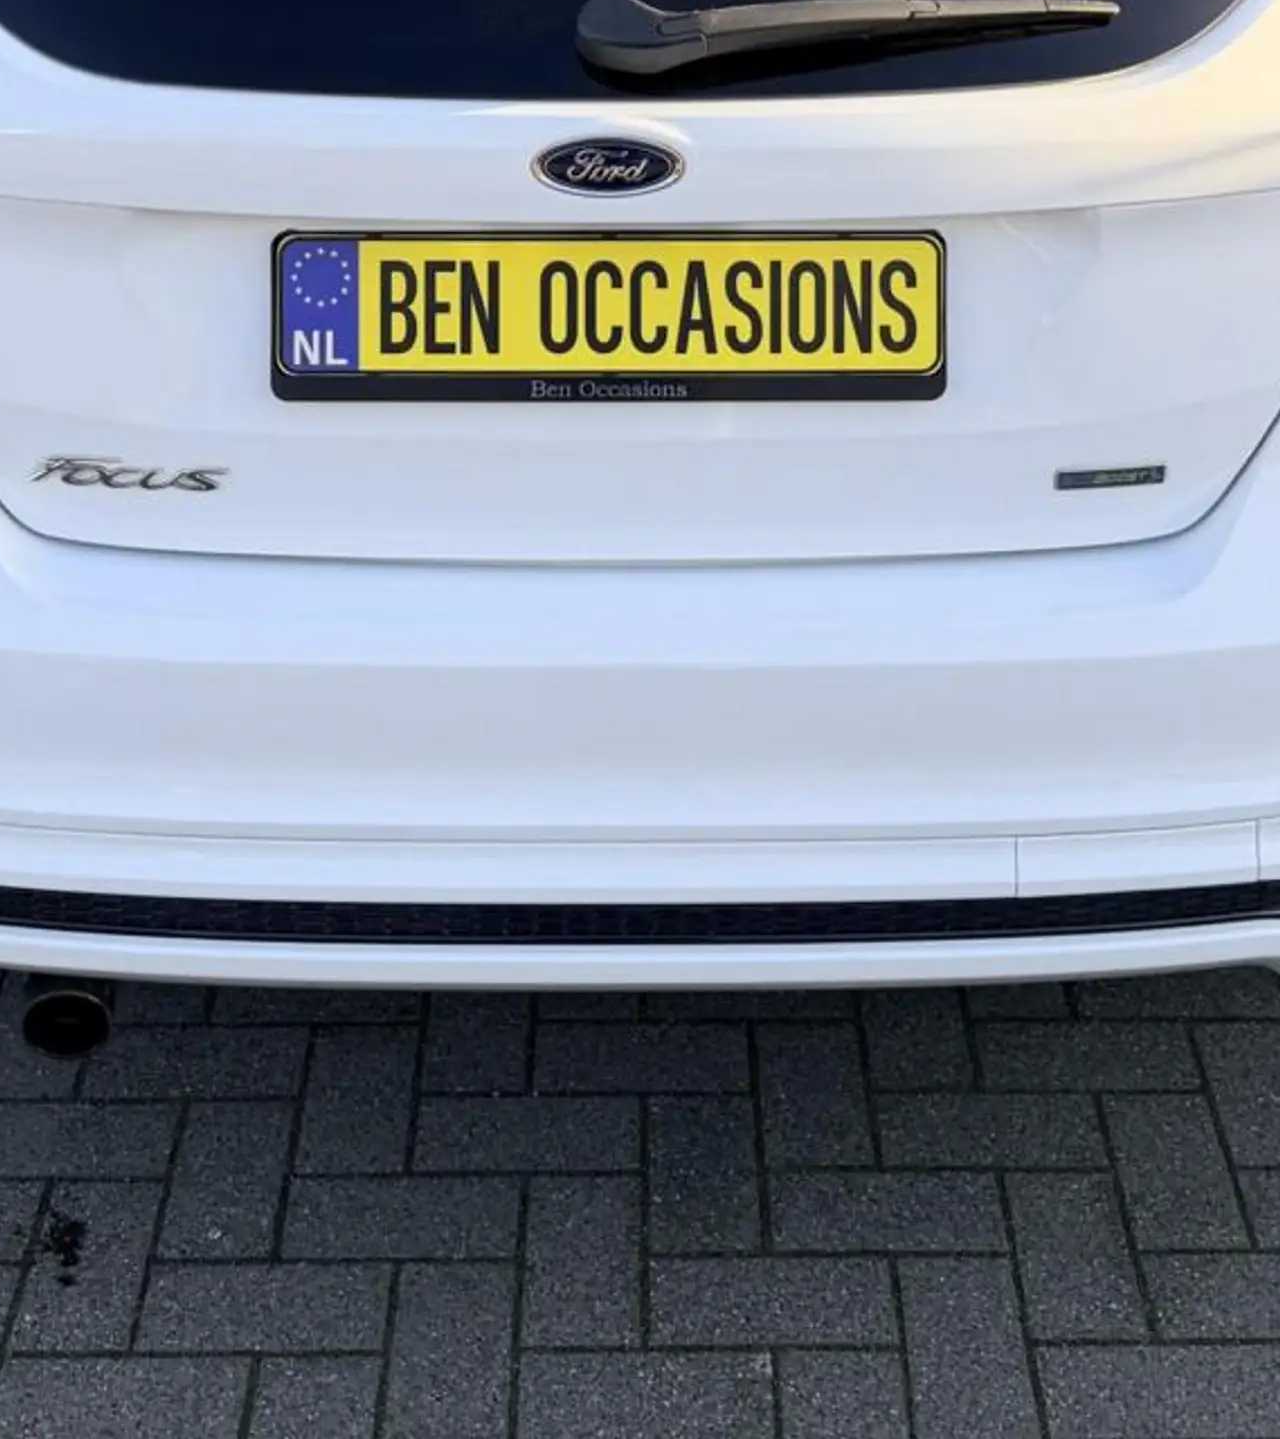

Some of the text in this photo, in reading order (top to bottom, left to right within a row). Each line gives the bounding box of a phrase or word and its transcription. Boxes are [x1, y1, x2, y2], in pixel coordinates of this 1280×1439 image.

[567, 148, 648, 183] Ford
[379, 259, 918, 356] BEN OCCASIONS
[293, 329, 349, 367] NL
[530, 379, 688, 398] Ben Occasions
